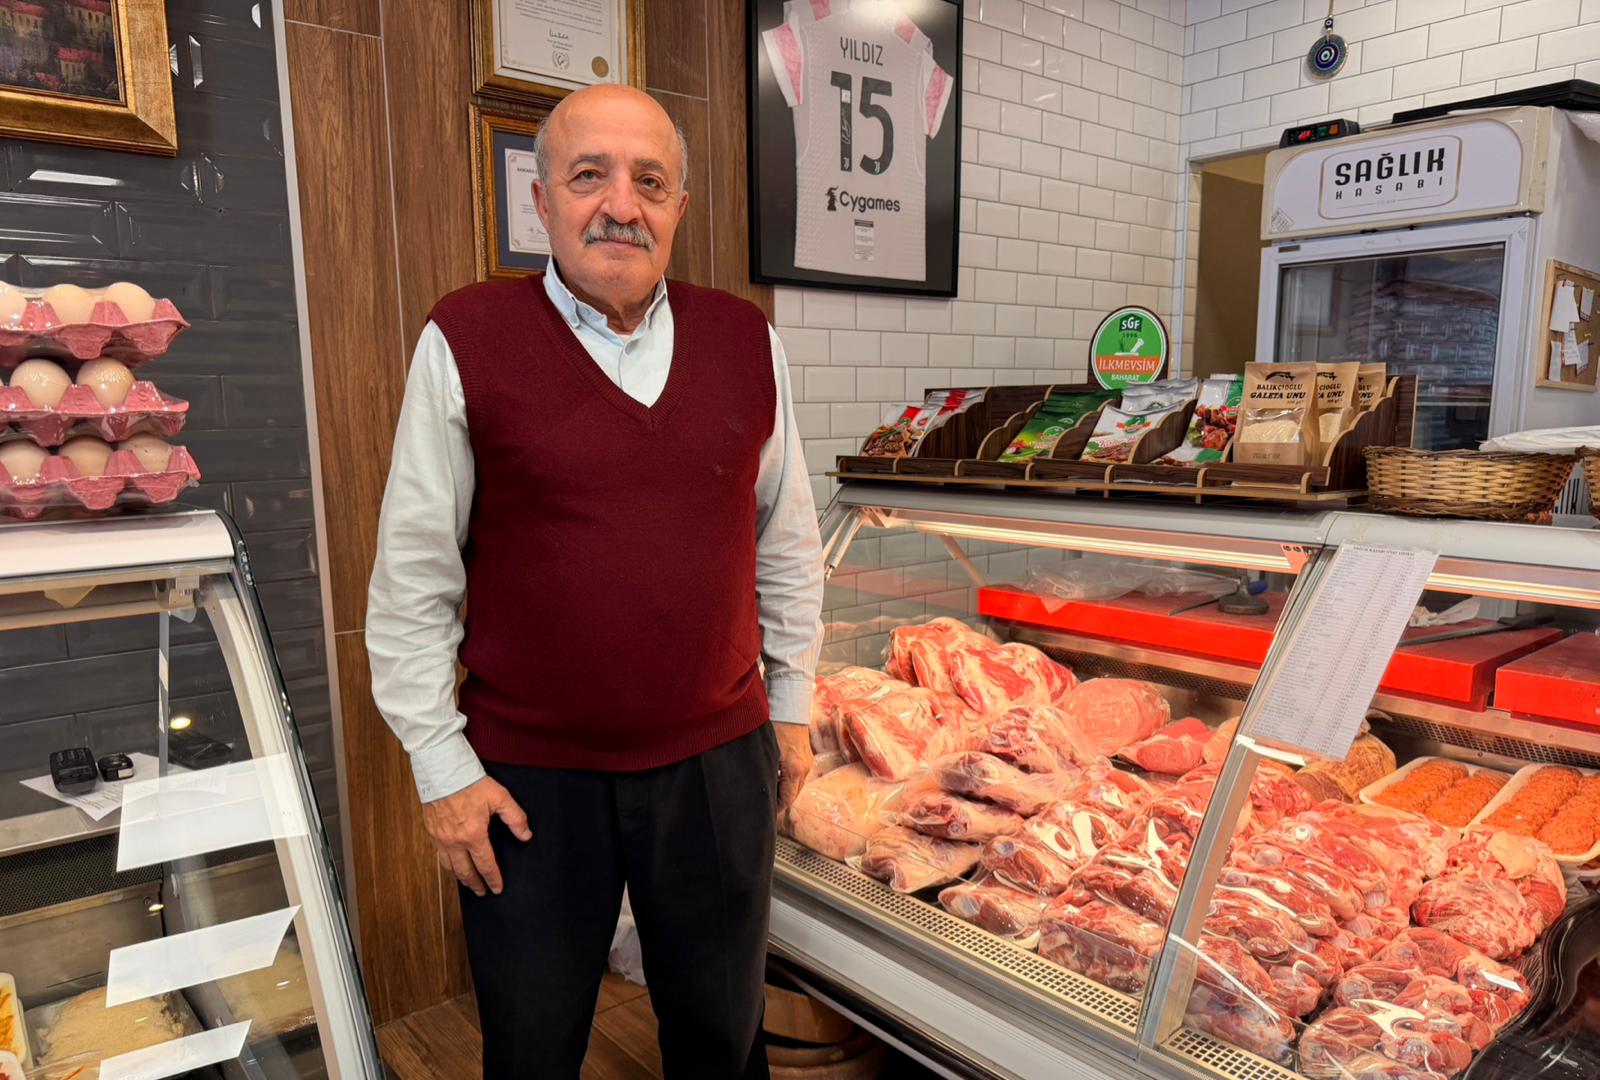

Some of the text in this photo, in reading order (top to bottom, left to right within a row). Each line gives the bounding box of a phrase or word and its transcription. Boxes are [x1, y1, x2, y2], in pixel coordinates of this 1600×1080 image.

[840, 36, 884, 66] YILDIZ
[830, 70, 895, 176] 15
[1335, 148, 1445, 186] SAĞLIK
[1335, 176, 1443, 200] KASABI
[839, 190, 901, 214] Cygames
[1121, 316, 1141, 330] SGF
[1098, 356, 1156, 372] İLKMEVSİM
[1250, 391, 1307, 399] GALETA UNU
[1327, 390, 1345, 399] UNU
